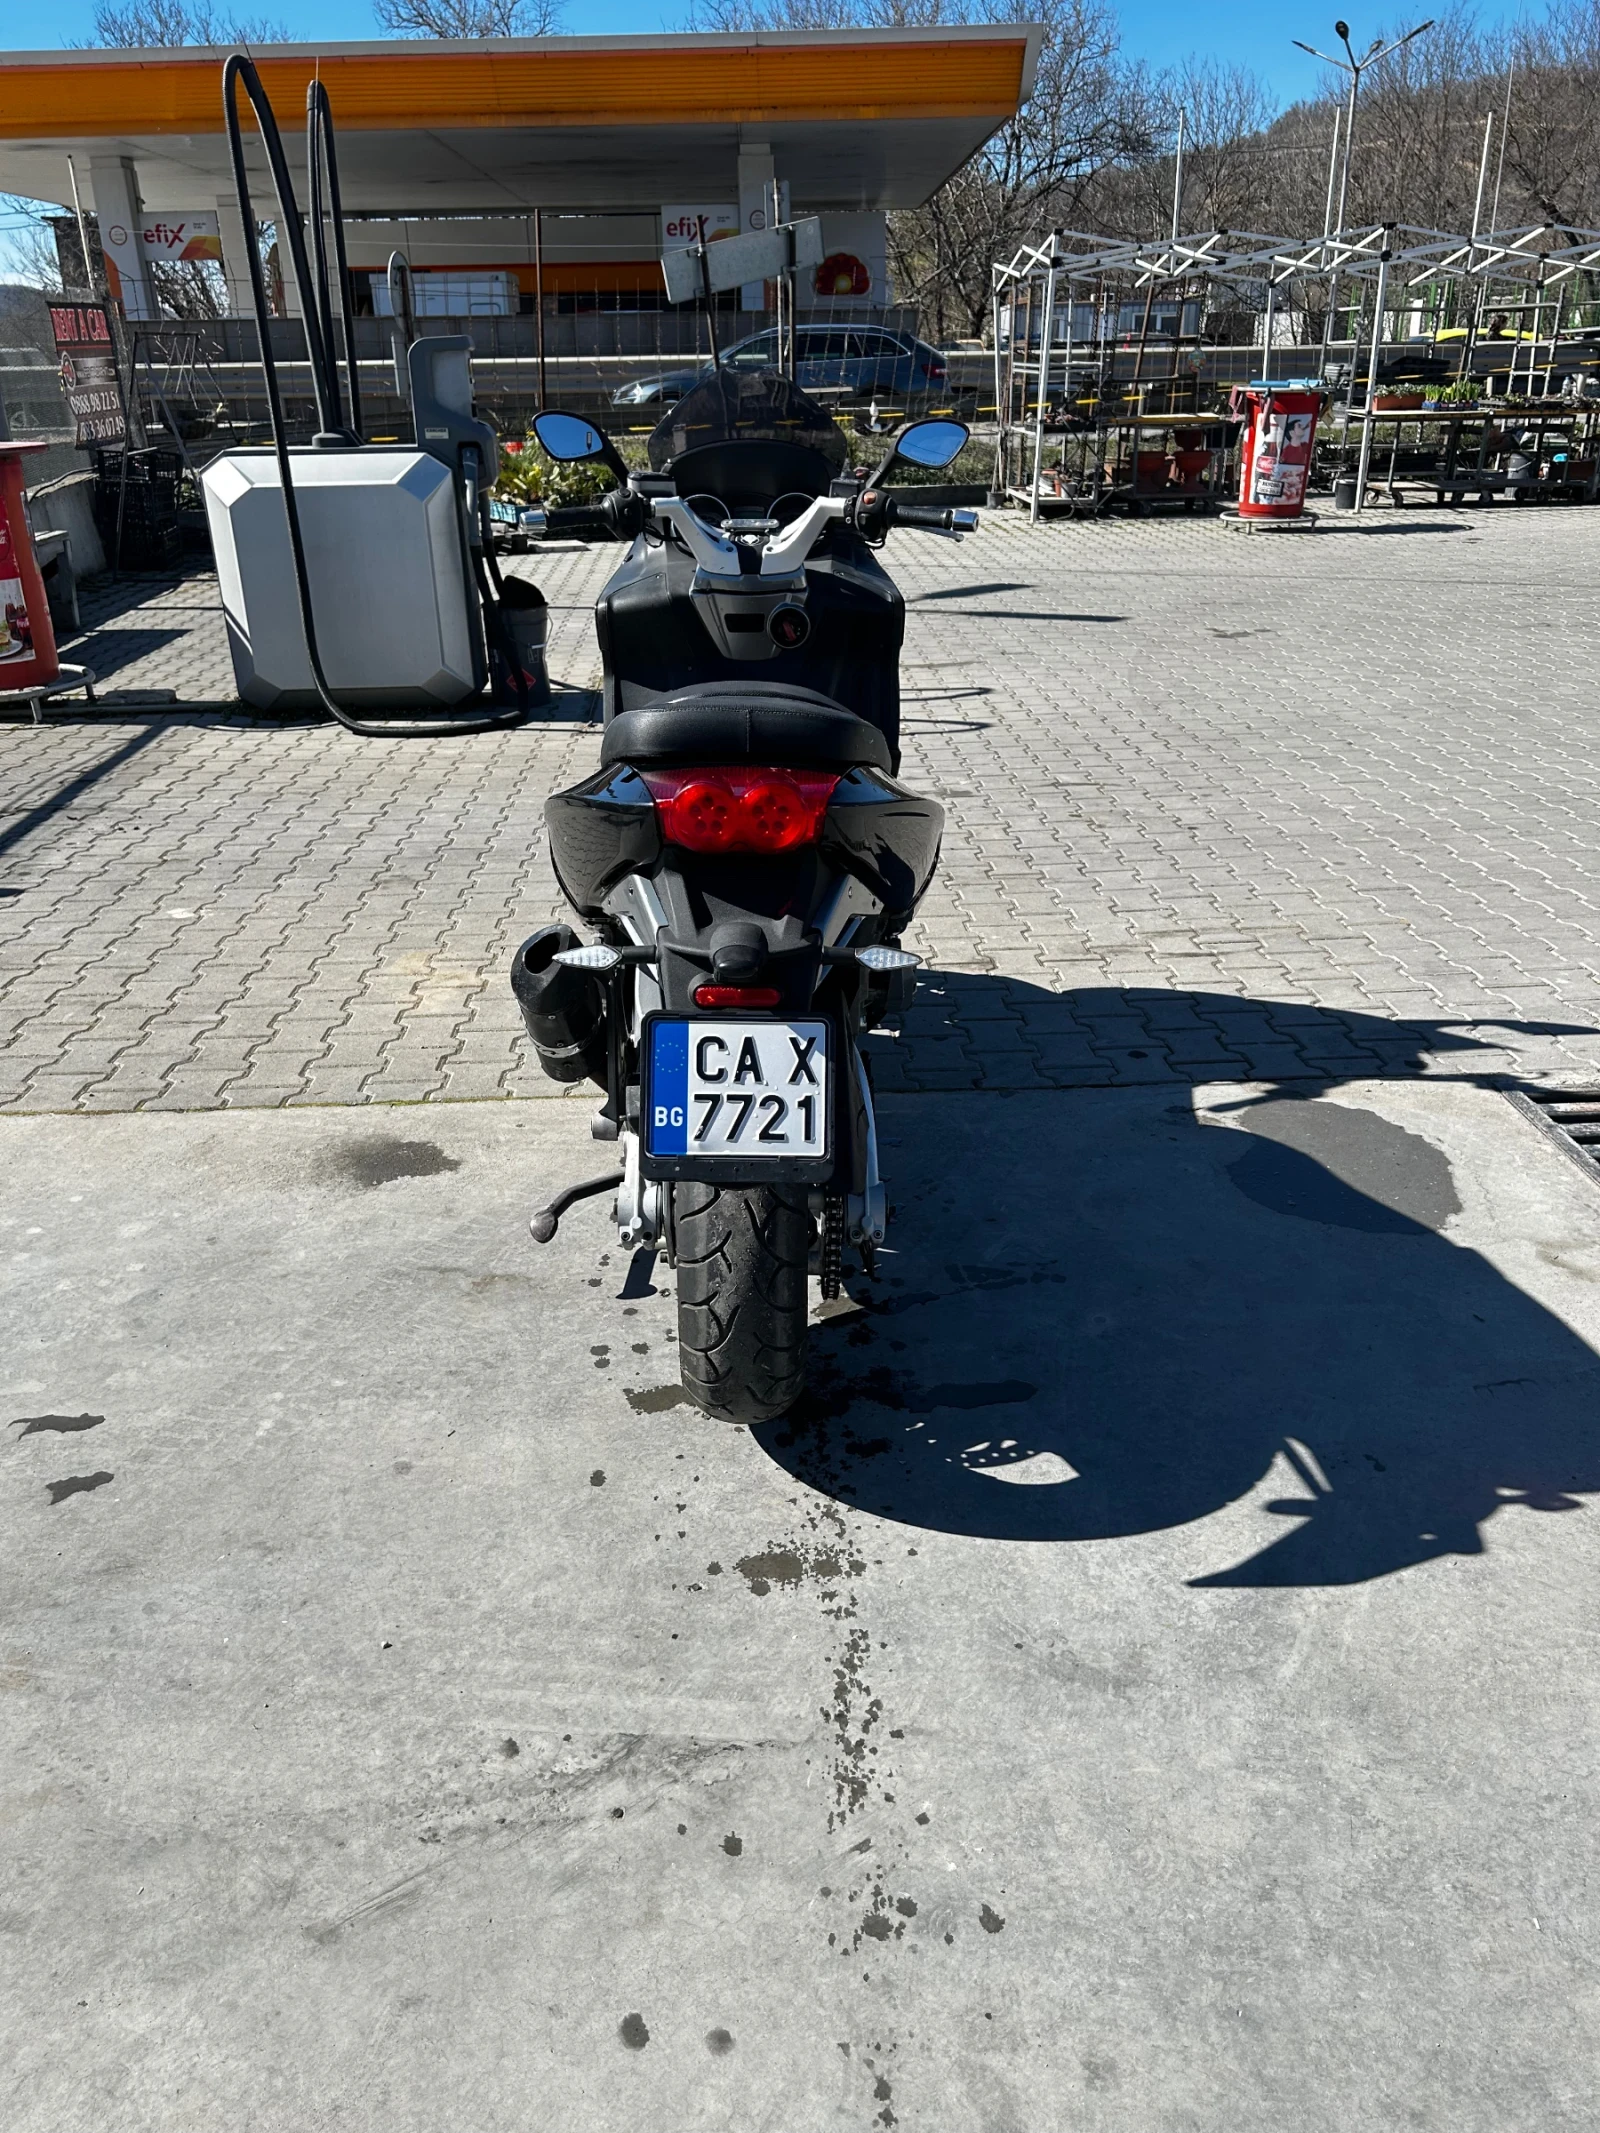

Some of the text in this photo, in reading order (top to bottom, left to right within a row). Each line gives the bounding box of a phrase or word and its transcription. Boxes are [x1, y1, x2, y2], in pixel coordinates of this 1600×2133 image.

[50, 308, 111, 341] RENT A CAR
[696, 1035, 819, 1085] CA X
[654, 1106, 684, 1127] BG
[693, 1093, 818, 1142] 7721
